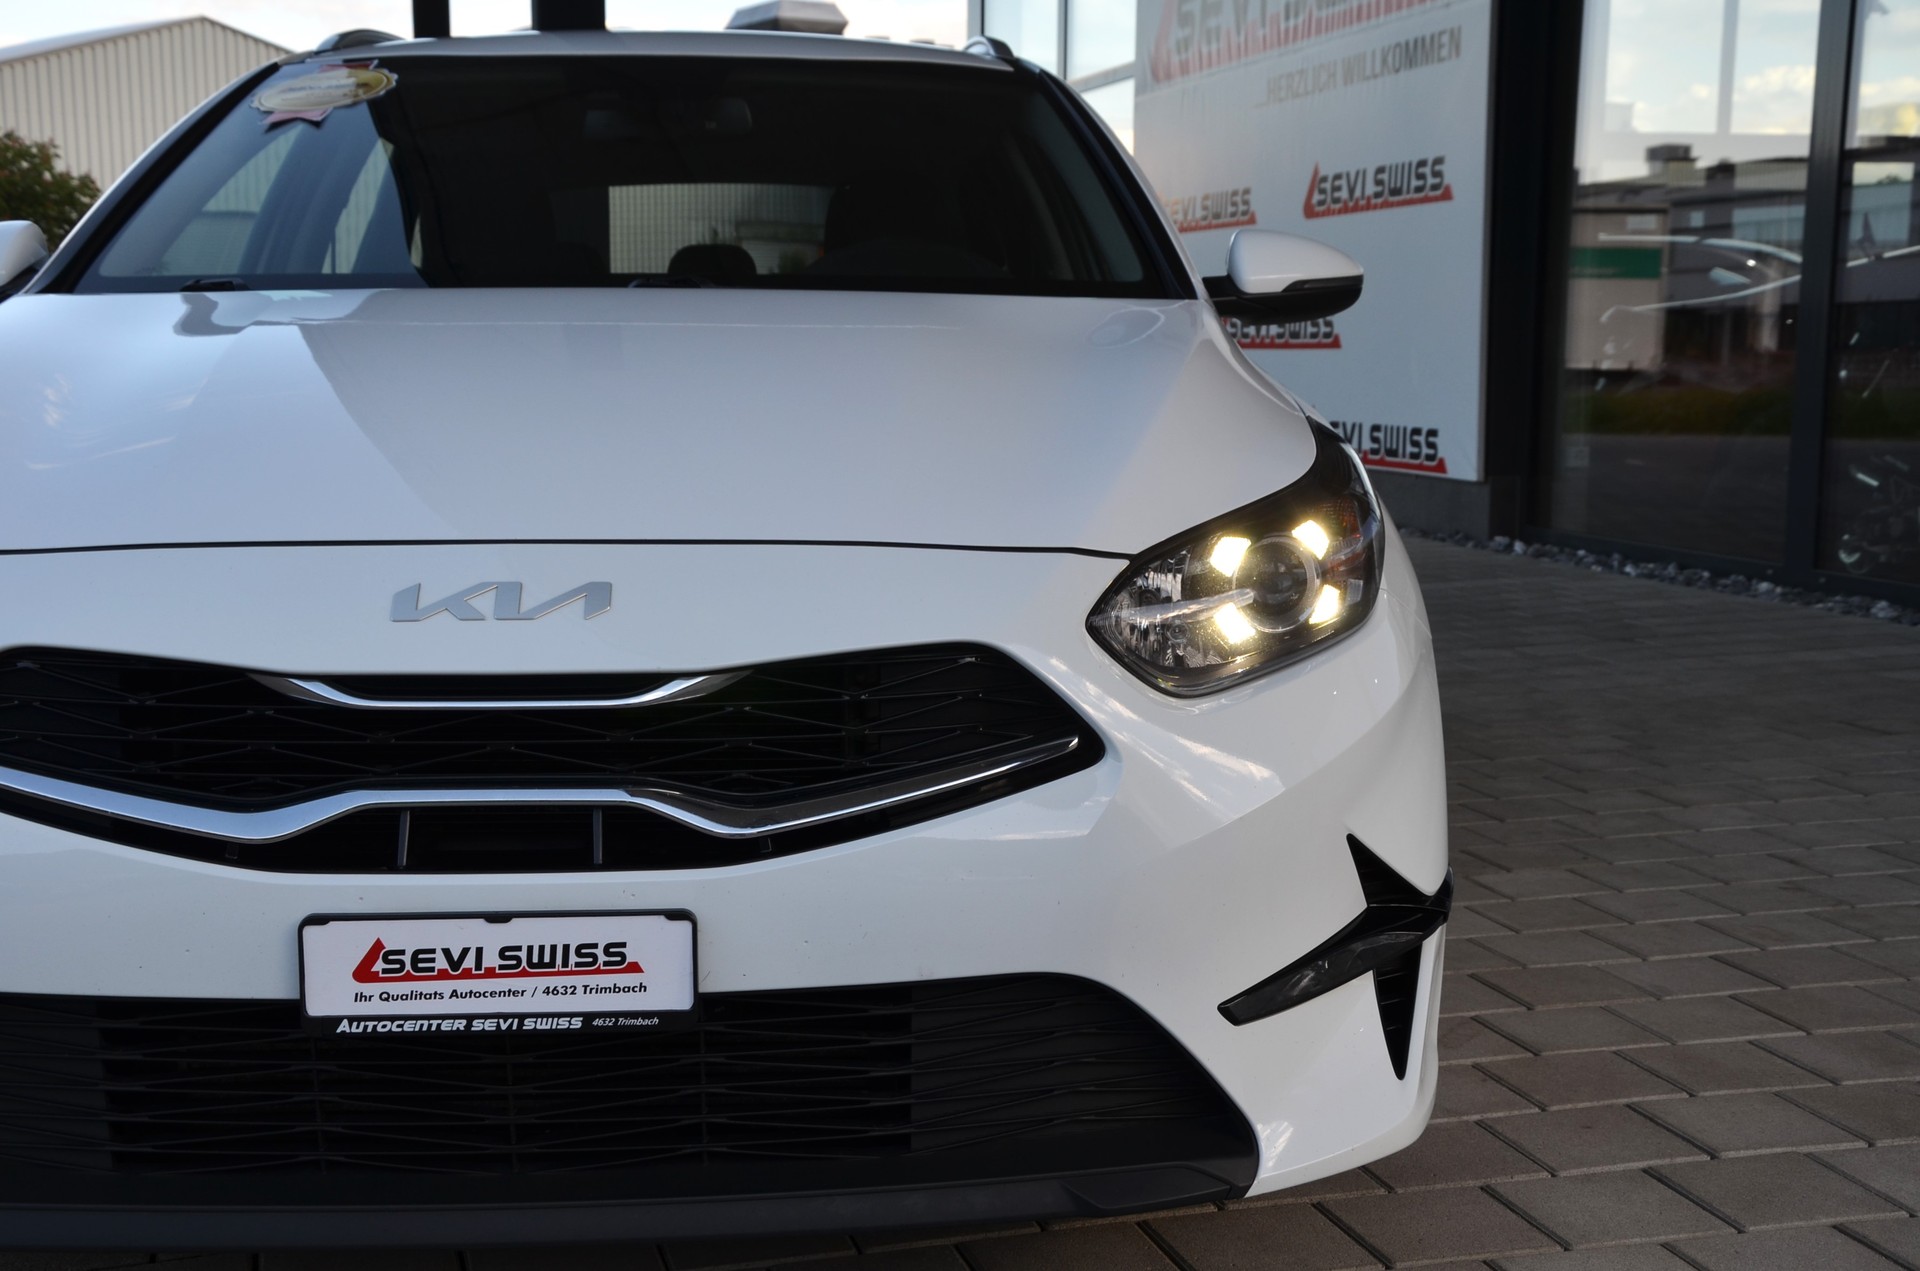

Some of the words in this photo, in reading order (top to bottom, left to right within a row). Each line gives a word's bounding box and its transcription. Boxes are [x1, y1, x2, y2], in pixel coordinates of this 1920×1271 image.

[1342, 25, 1462, 86] WILLKOMMEN
[1316, 168, 1366, 207] SEVI
[1372, 155, 1445, 200] SWISS
[1200, 187, 1251, 221] SWISS
[1369, 423, 1438, 462] SWISS
[390, 581, 612, 622] KIA
[381, 946, 484, 975] SEVI
[497, 942, 627, 971] SWISS
[353, 991, 374, 1003] Ihr
[378, 989, 445, 1002] Qualitats
[448, 988, 527, 1000] Autocenter
[530, 986, 538, 998] /
[542, 984, 577, 996] 4632
[582, 982, 648, 995] Trimbach
[470, 1018, 518, 1031] SEVI
[522, 1016, 583, 1030] SWISS
[591, 1017, 615, 1026] 4632
[617, 1016, 659, 1026] Trimbach
